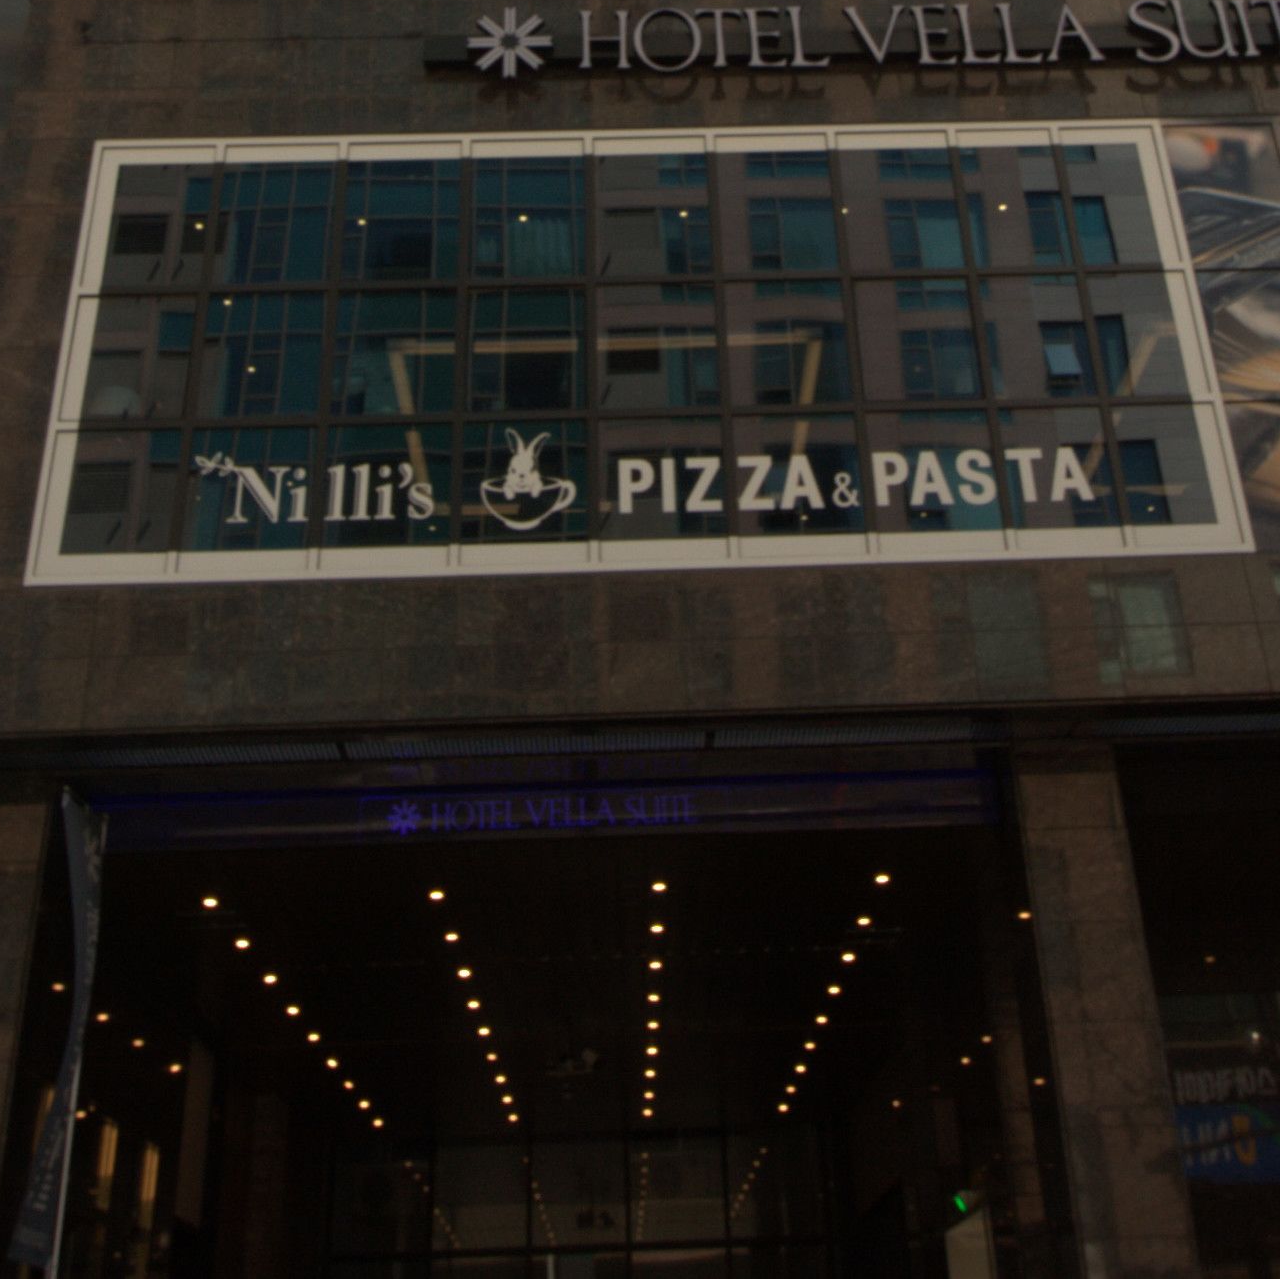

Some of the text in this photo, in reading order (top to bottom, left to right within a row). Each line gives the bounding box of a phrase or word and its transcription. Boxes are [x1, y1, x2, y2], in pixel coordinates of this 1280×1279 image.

[578, 5, 829, 73] HOTEL
[843, 3, 1103, 67] VELLA
[224, 445, 1095, 525] Nilli's PIZZA & PASTA
[430, 794, 697, 832] HOTEL VELLA SUITE
